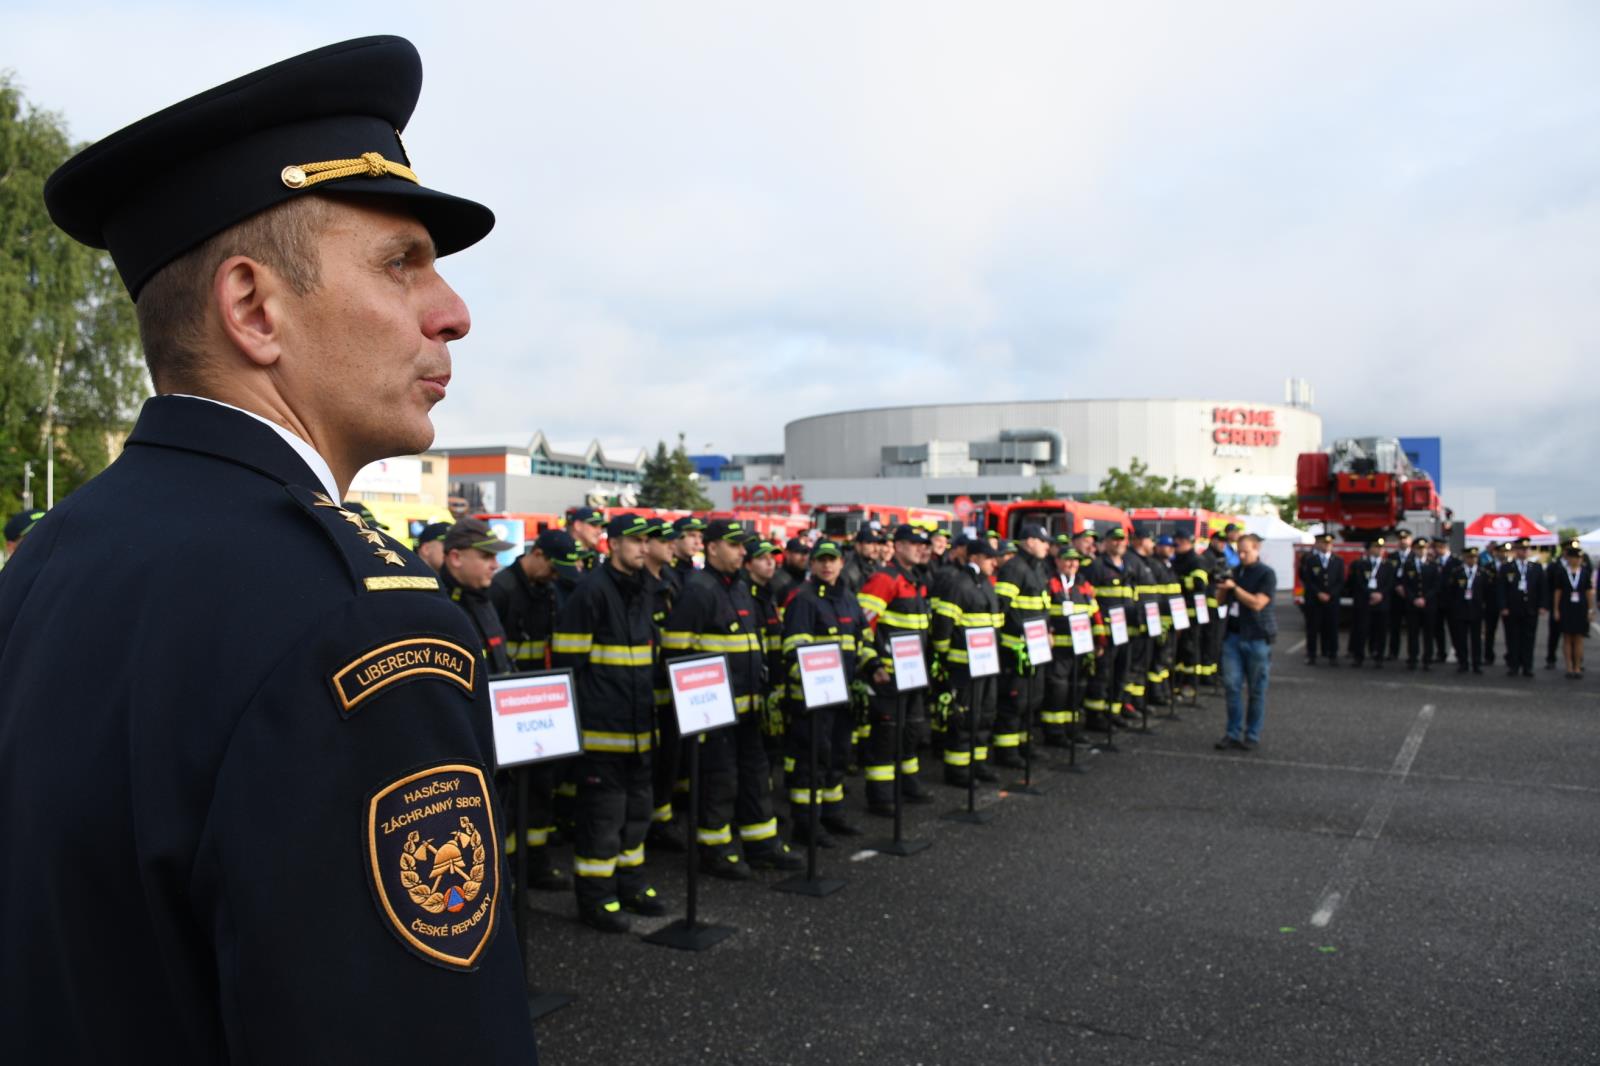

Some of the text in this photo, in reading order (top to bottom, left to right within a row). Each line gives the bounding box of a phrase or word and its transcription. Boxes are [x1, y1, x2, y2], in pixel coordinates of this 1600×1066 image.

[1213, 408, 1275, 426] HOME
[1213, 427, 1281, 447] CREDIT
[732, 484, 804, 502] HOME
[356, 647, 464, 687] LIBERECKÝ KRAJ
[404, 778, 460, 804] HASIČSKÝ
[381, 796, 481, 835] ZÁCHRANNÝ SBOR
[411, 892, 491, 937] ČESKÉ REPUBLIKY
